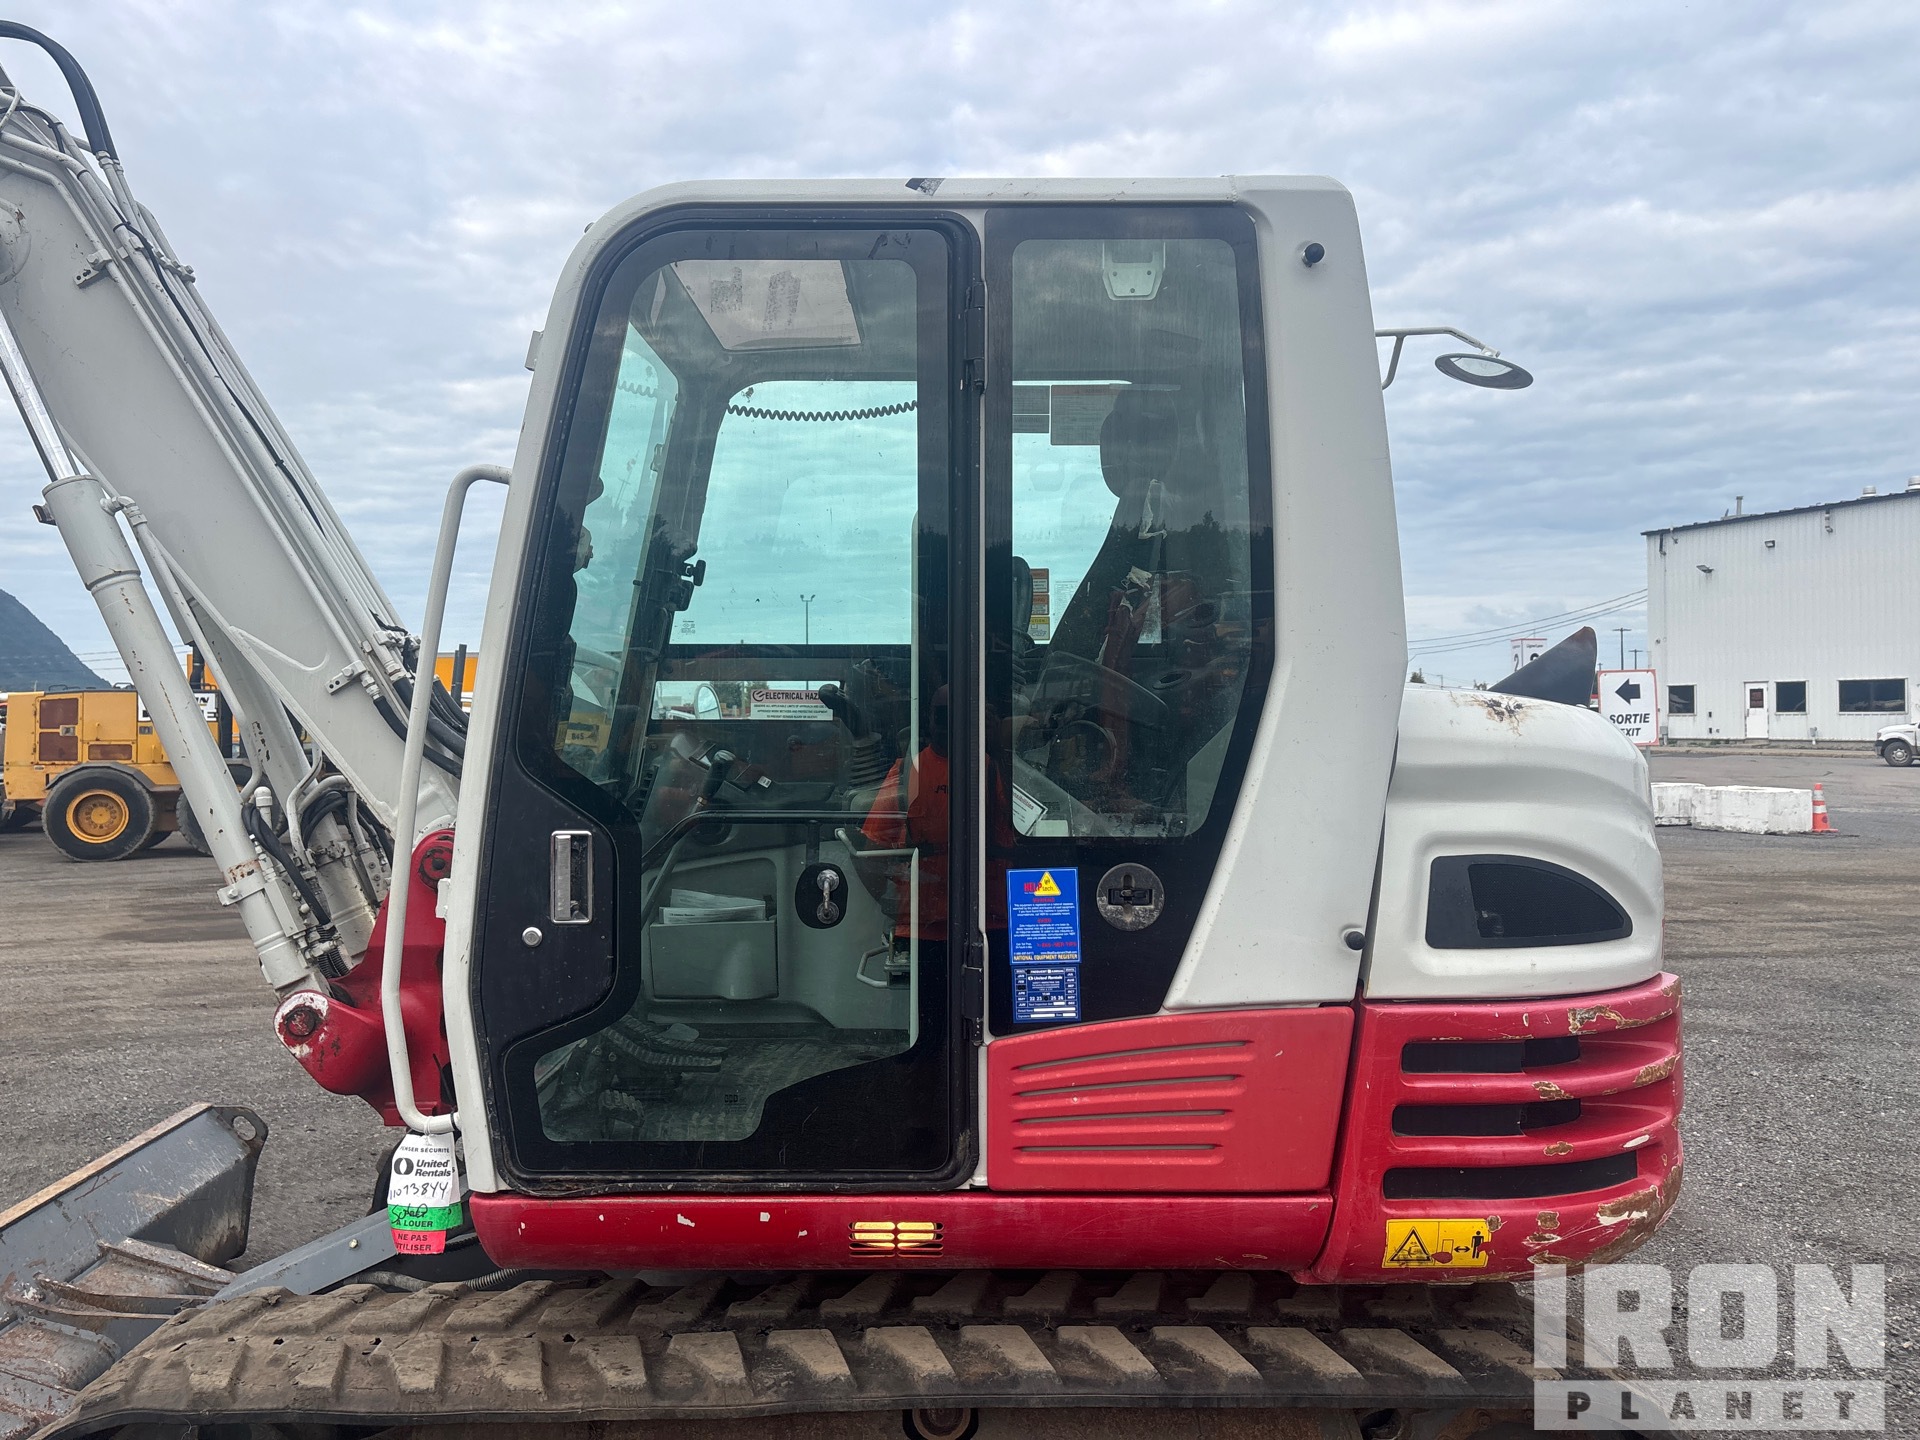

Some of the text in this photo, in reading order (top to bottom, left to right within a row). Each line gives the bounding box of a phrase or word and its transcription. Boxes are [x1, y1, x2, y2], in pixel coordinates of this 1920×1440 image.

[765, 692, 820, 701] ELECTRICAL HAZ
[1609, 713, 1651, 725] SORTIE
[416, 1159, 450, 1168] United
[414, 1168, 452, 1177] Rentals
[404, 1220, 434, 1228] LOUER
[397, 1233, 429, 1242] NE PAS
